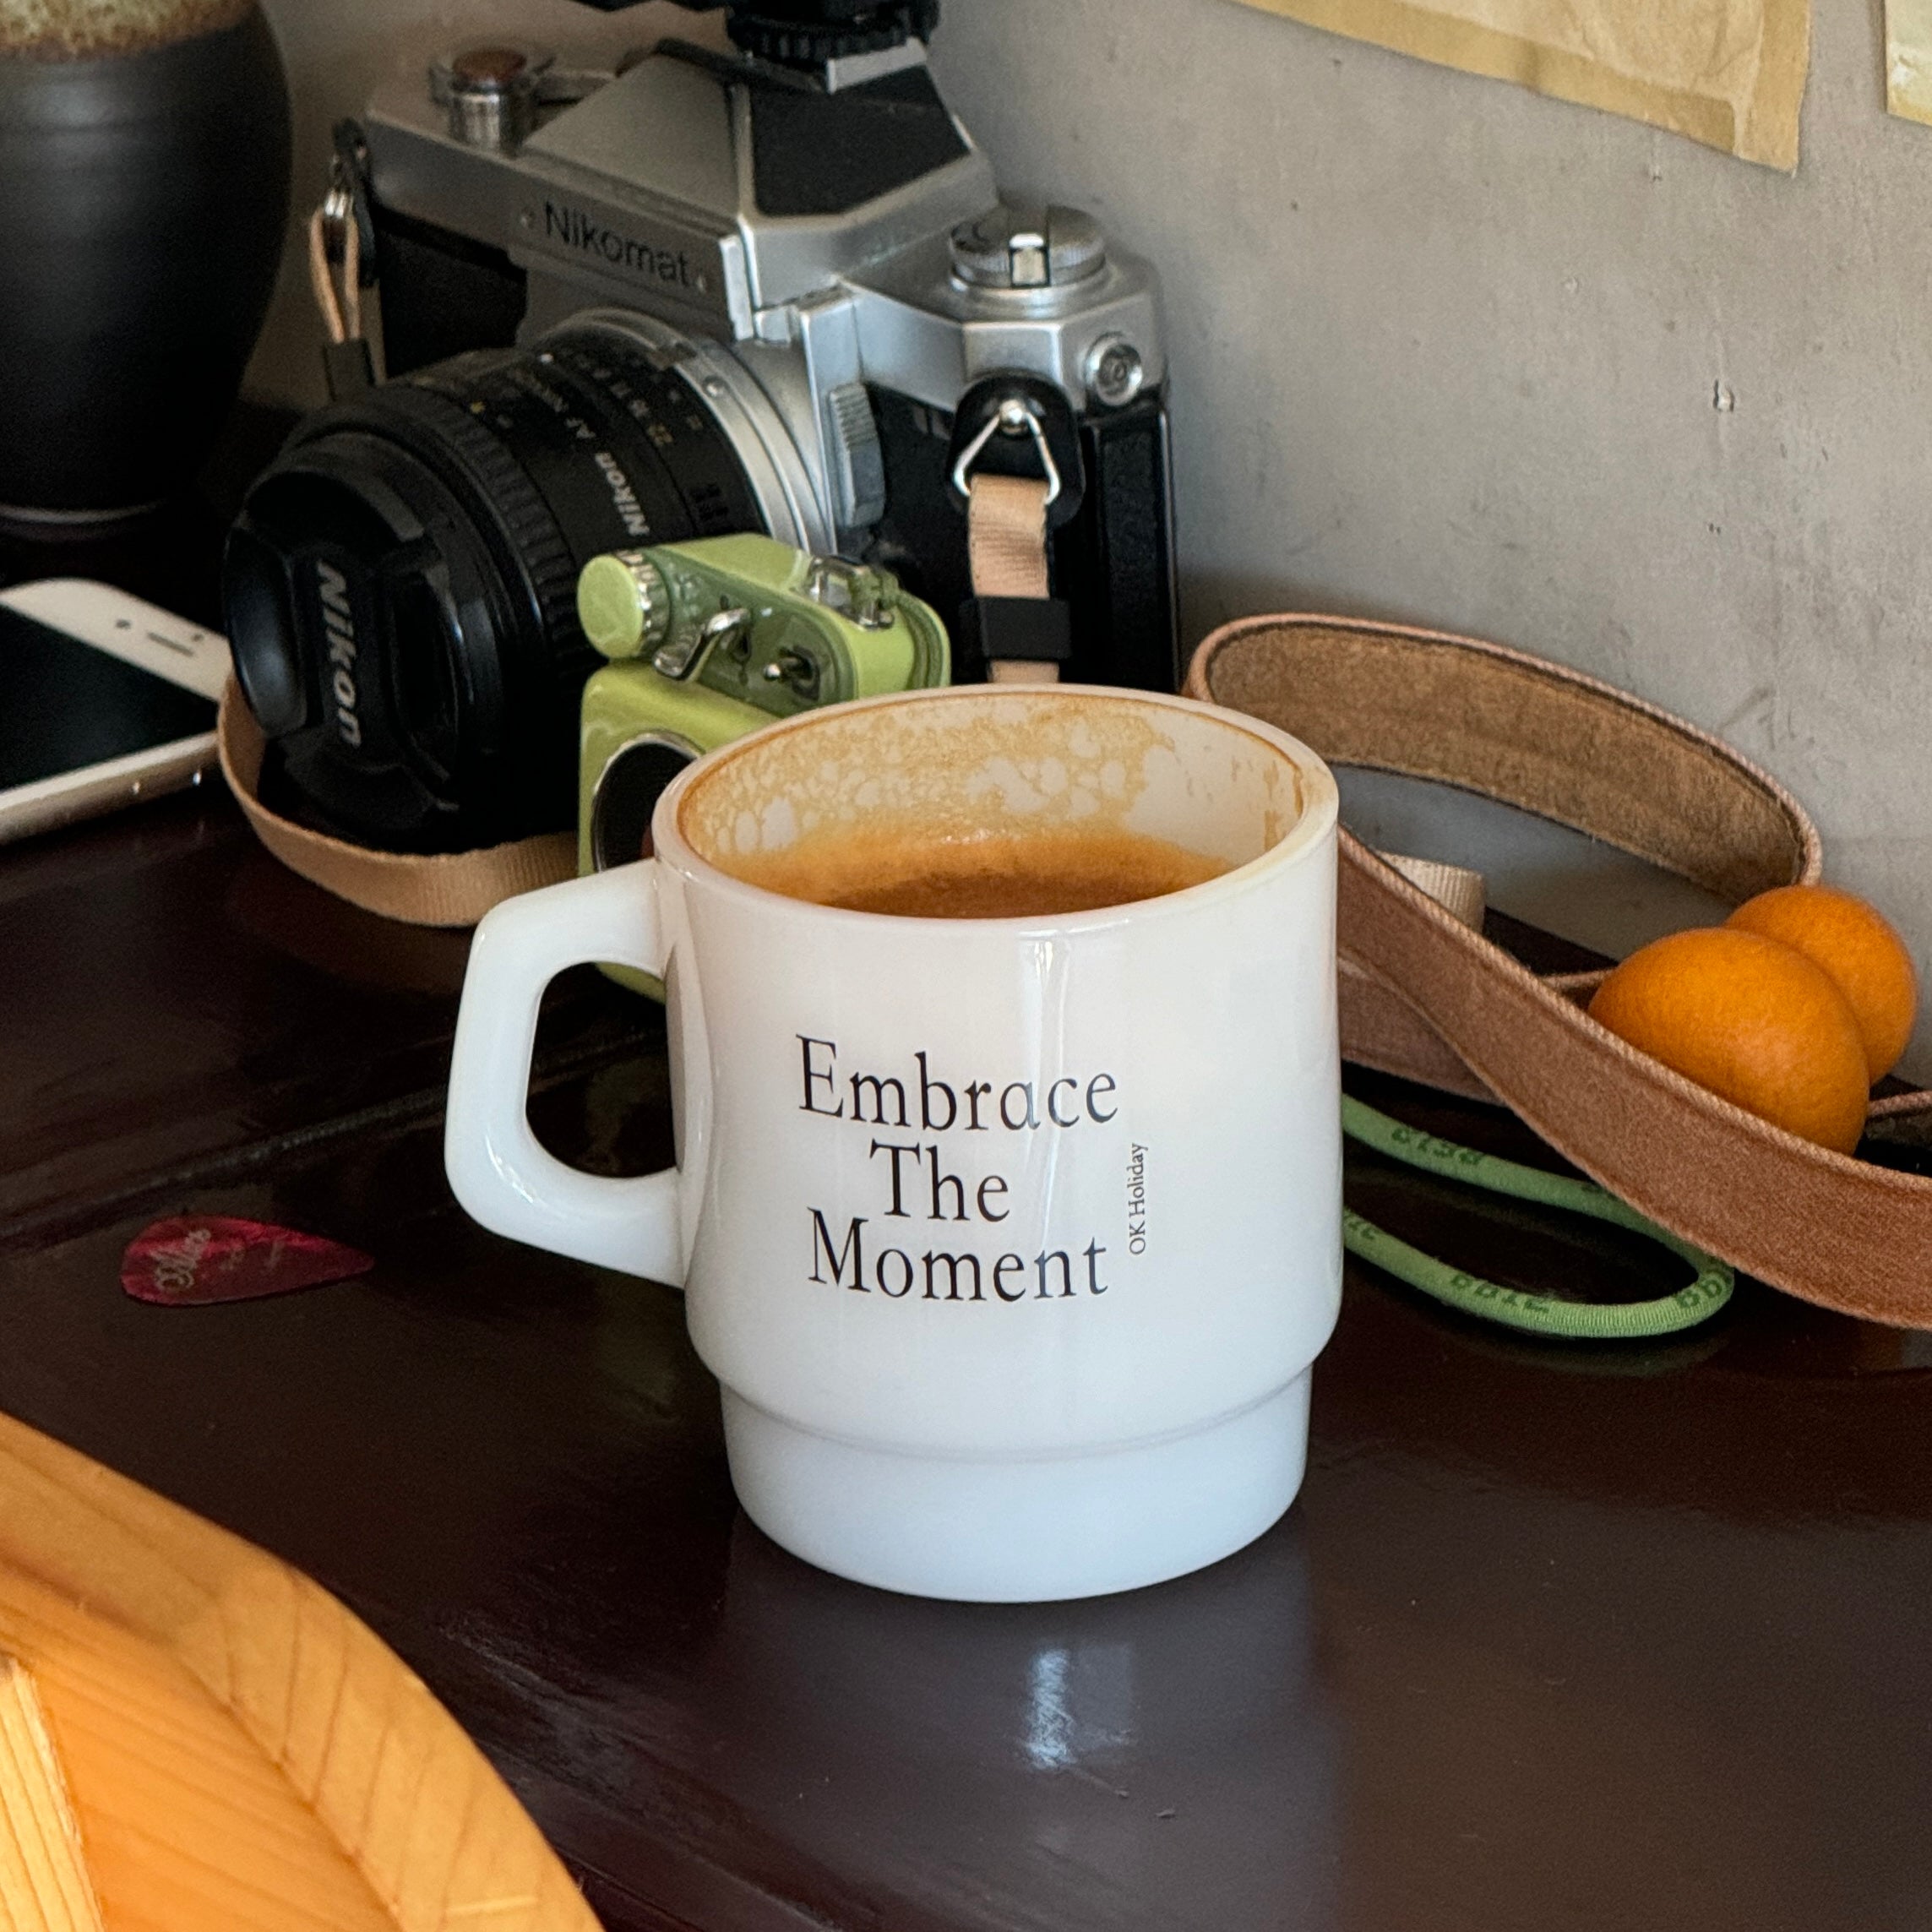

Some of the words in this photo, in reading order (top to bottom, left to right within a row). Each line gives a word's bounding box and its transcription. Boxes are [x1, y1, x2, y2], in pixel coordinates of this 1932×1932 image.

[545, 201, 689, 286] Nikomat
[796, 1033, 1118, 1132] Embrace
[869, 1138, 1010, 1223] The
[1126, 1142, 1150, 1218] Holiday
[806, 1206, 1109, 1303] Moment
[1128, 1220, 1147, 1256] OK
